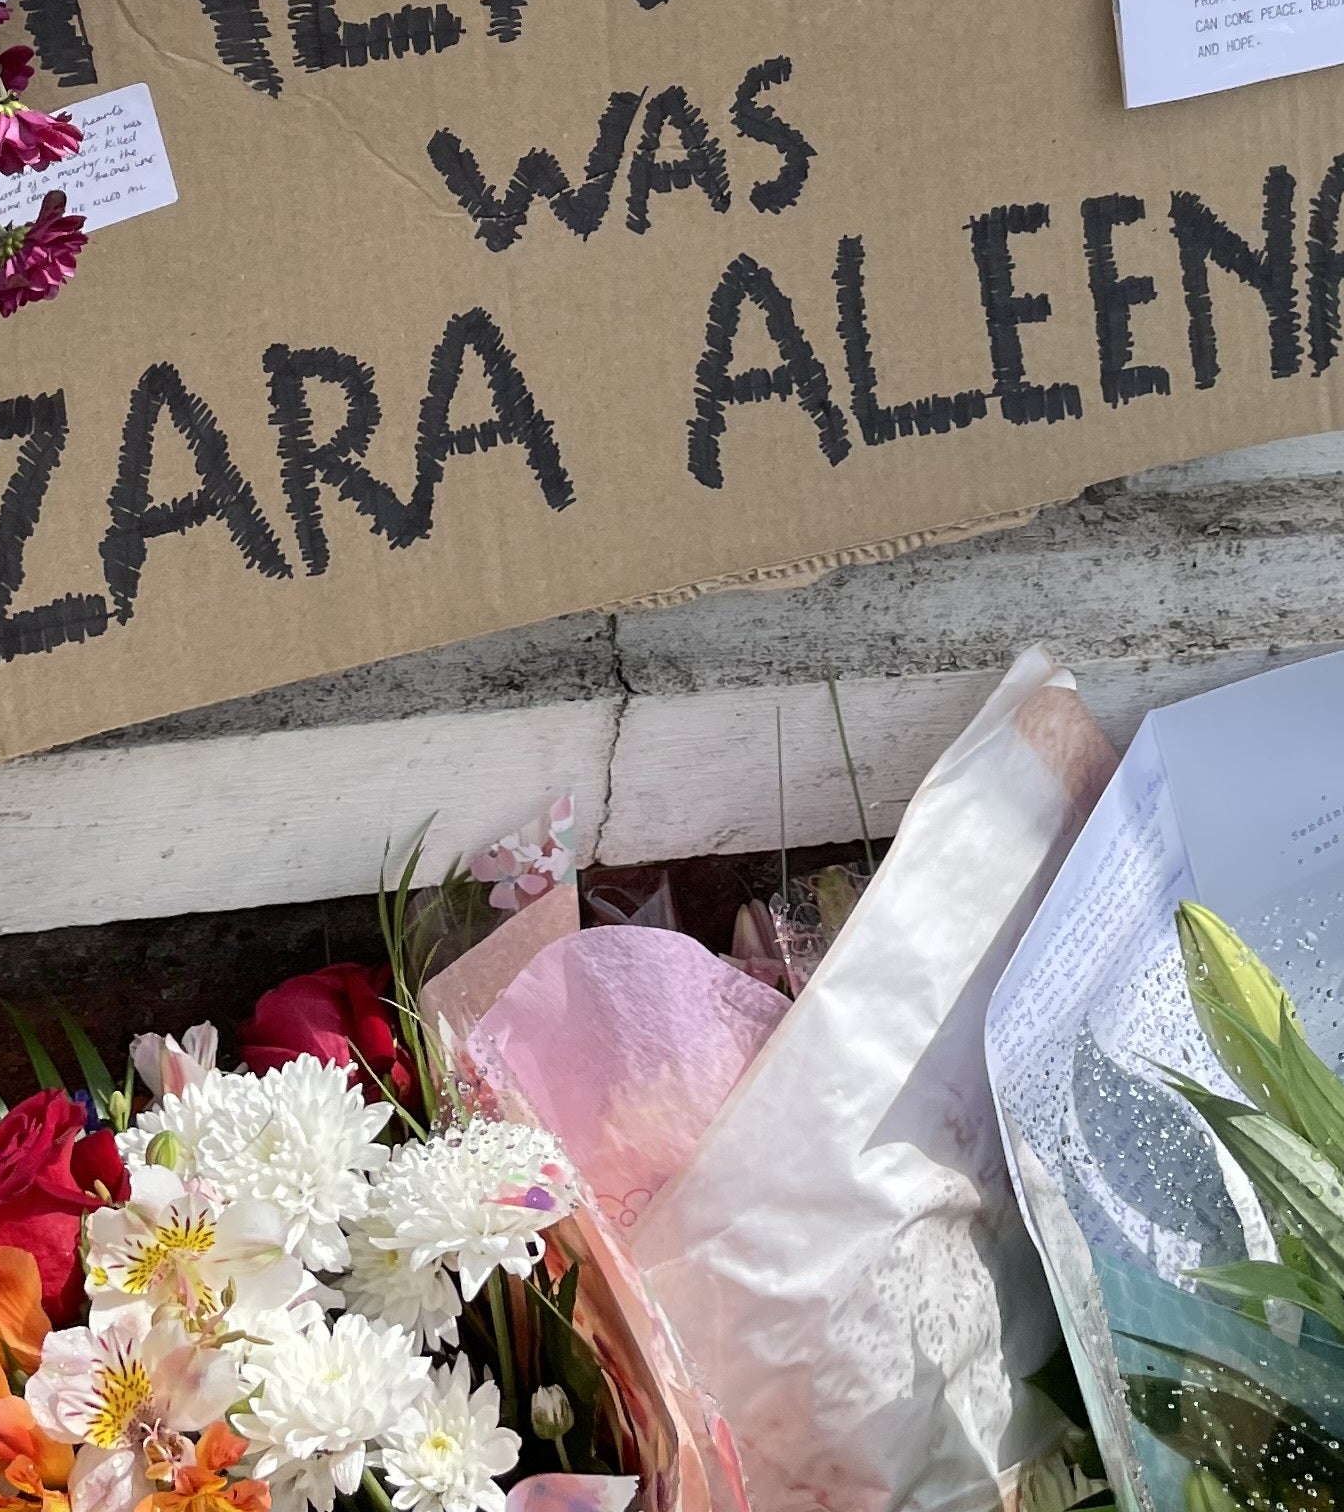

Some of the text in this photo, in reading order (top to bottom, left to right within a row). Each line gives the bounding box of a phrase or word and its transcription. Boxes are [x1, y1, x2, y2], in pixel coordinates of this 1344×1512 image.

[1195, 16, 1218, 33] CAN
[1224, 9, 1254, 27] COME
[1197, 35, 1261, 58] AND HOPE.
[58, 158, 100, 179] martyr
[120, 148, 137, 160] the
[426, 55, 818, 254] WAS
[1314, 834, 1340, 855] and
